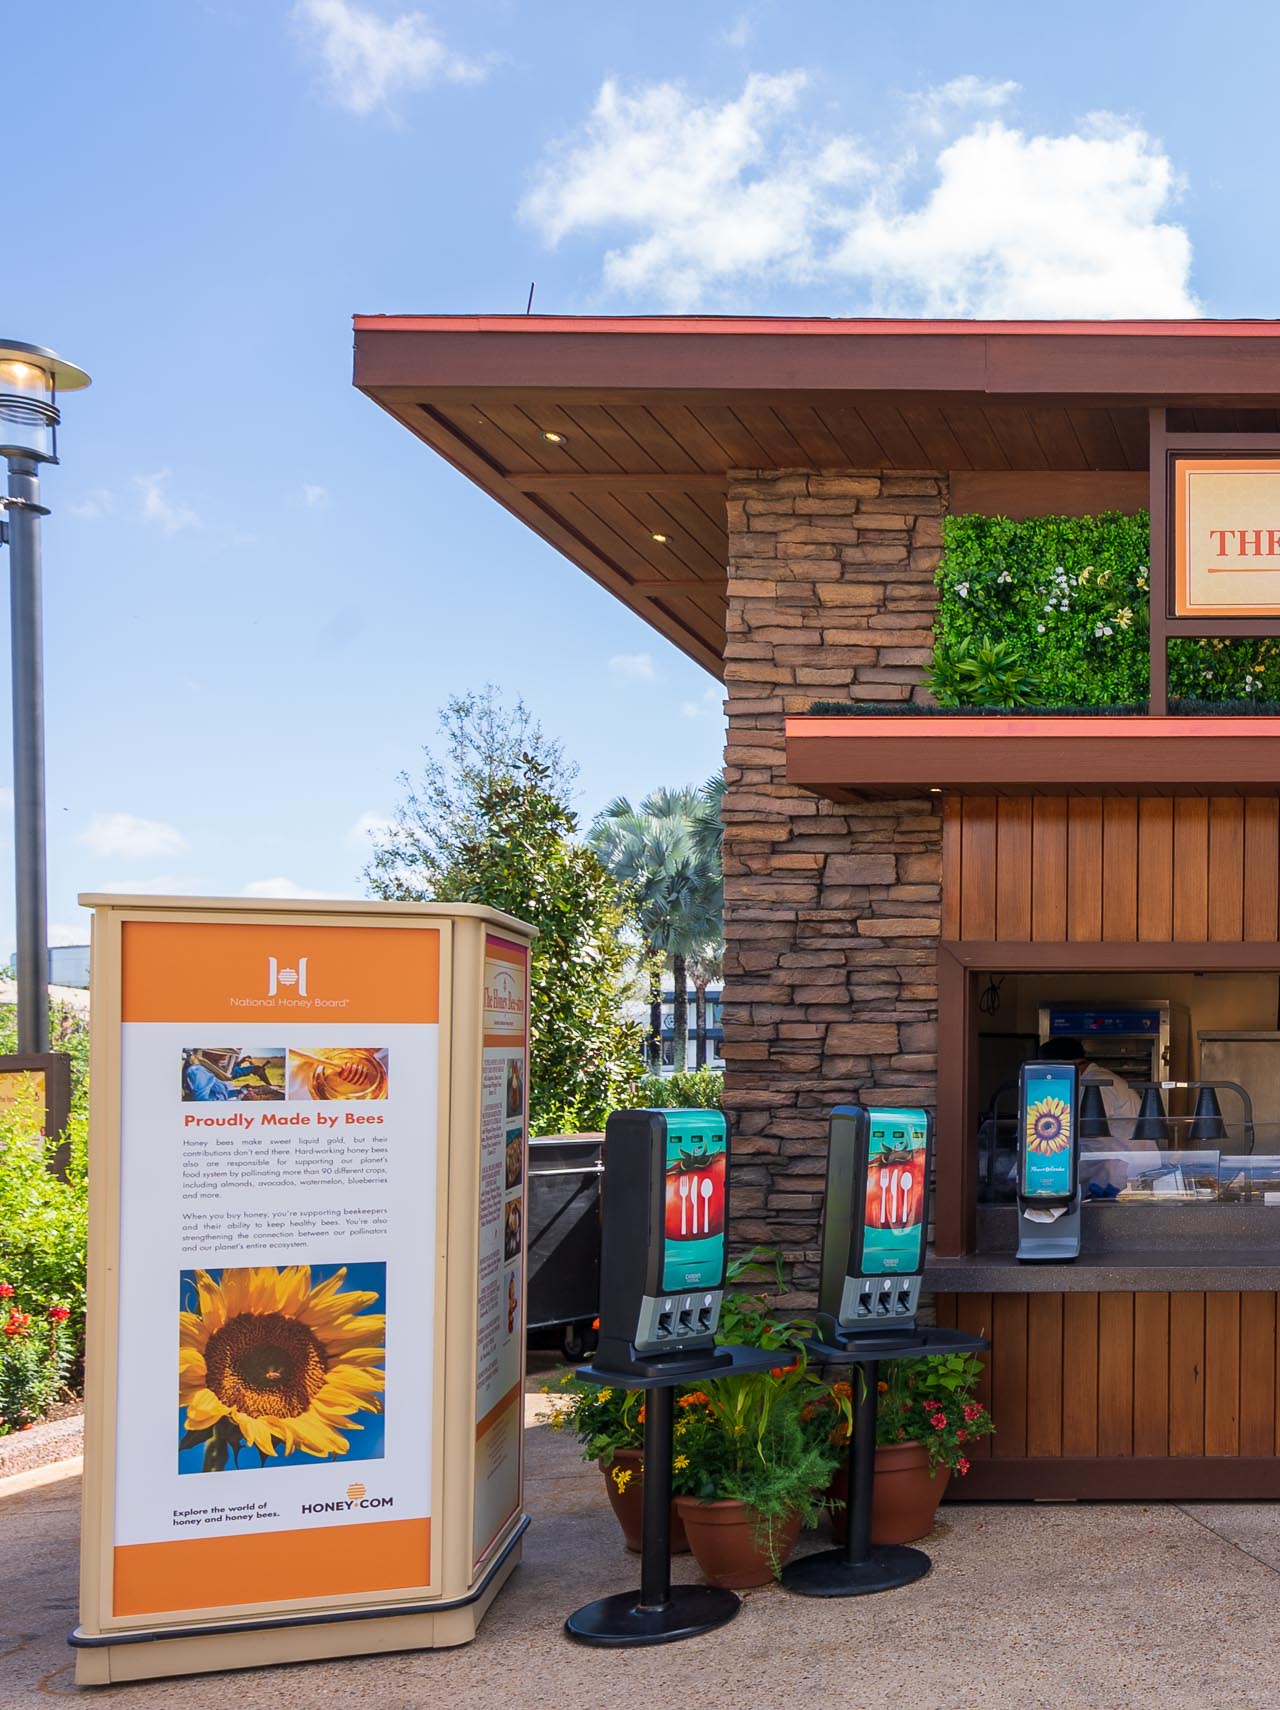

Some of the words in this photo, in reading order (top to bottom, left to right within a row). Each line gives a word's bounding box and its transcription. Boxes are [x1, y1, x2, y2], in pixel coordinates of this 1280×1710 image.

[230, 998, 275, 1007] National
[278, 998, 311, 1008] Honey
[184, 1114, 254, 1129] Proudly
[261, 1113, 310, 1125] Made
[317, 1113, 338, 1127] by
[345, 1113, 384, 1124] Bees
[183, 1139, 208, 1147] Honey
[299, 1137, 319, 1145] liquid
[183, 1149, 231, 1157] contributions
[227, 1159, 270, 1167] responsible
[295, 1157, 334, 1166] supporting
[360, 1157, 388, 1165] planet's
[203, 1170, 228, 1178] system
[229, 1170, 239, 1178] by
[241, 1169, 280, 1177] pollinating
[183, 1181, 217, 1189] including
[221, 1180, 254, 1188] almonds,
[300, 1178, 345, 1186] watermelon,
[227, 1211, 240, 1219] buy
[244, 1210, 269, 1219] honey,
[300, 1209, 341, 1217] supporting
[344, 1207, 387, 1215] beekeepers
[182, 1223, 198, 1231] and
[227, 1222, 250, 1230] ability
[290, 1219, 316, 1228] healthy
[345, 1217, 368, 1225] You're
[182, 1233, 233, 1241] strengthening
[298, 1229, 329, 1237] between
[350, 1227, 387, 1235] pollinators
[182, 1244, 197, 1252] and
[215, 1242, 244, 1252] planet's
[173, 1508, 208, 1517] Explore
[228, 1504, 255, 1512] world
[173, 1518, 201, 1526] honey
[225, 1514, 253, 1522] honey
